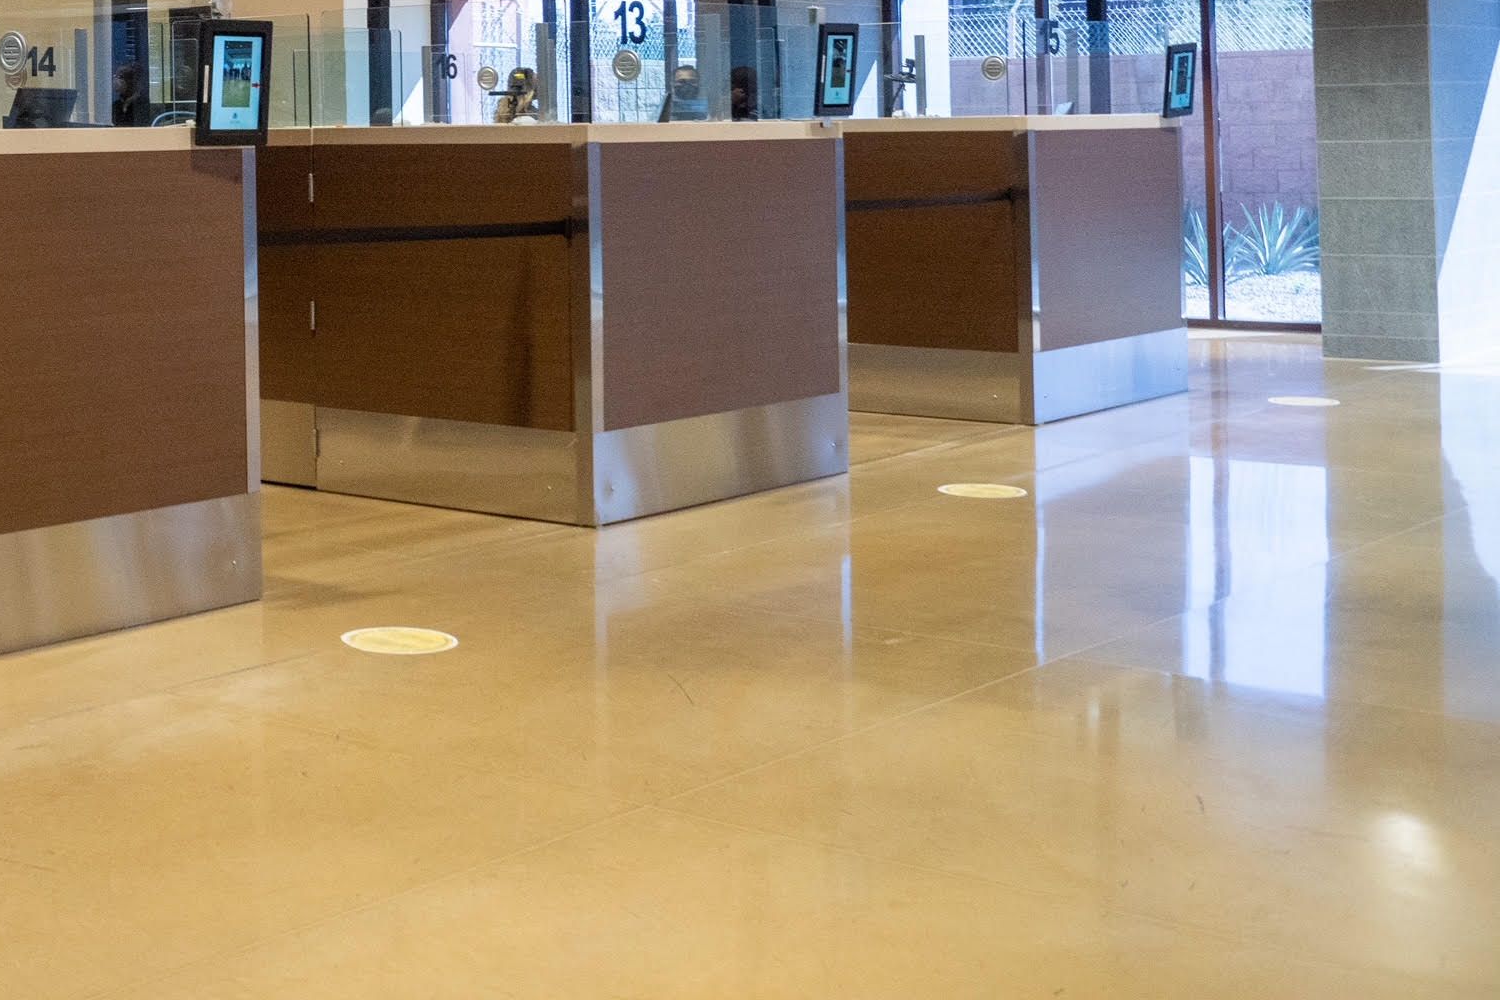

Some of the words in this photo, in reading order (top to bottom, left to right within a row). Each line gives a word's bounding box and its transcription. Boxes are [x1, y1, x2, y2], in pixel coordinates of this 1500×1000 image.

[614, 0, 647, 45] 13
[27, 46, 57, 77] 14
[435, 53, 458, 80] 16
